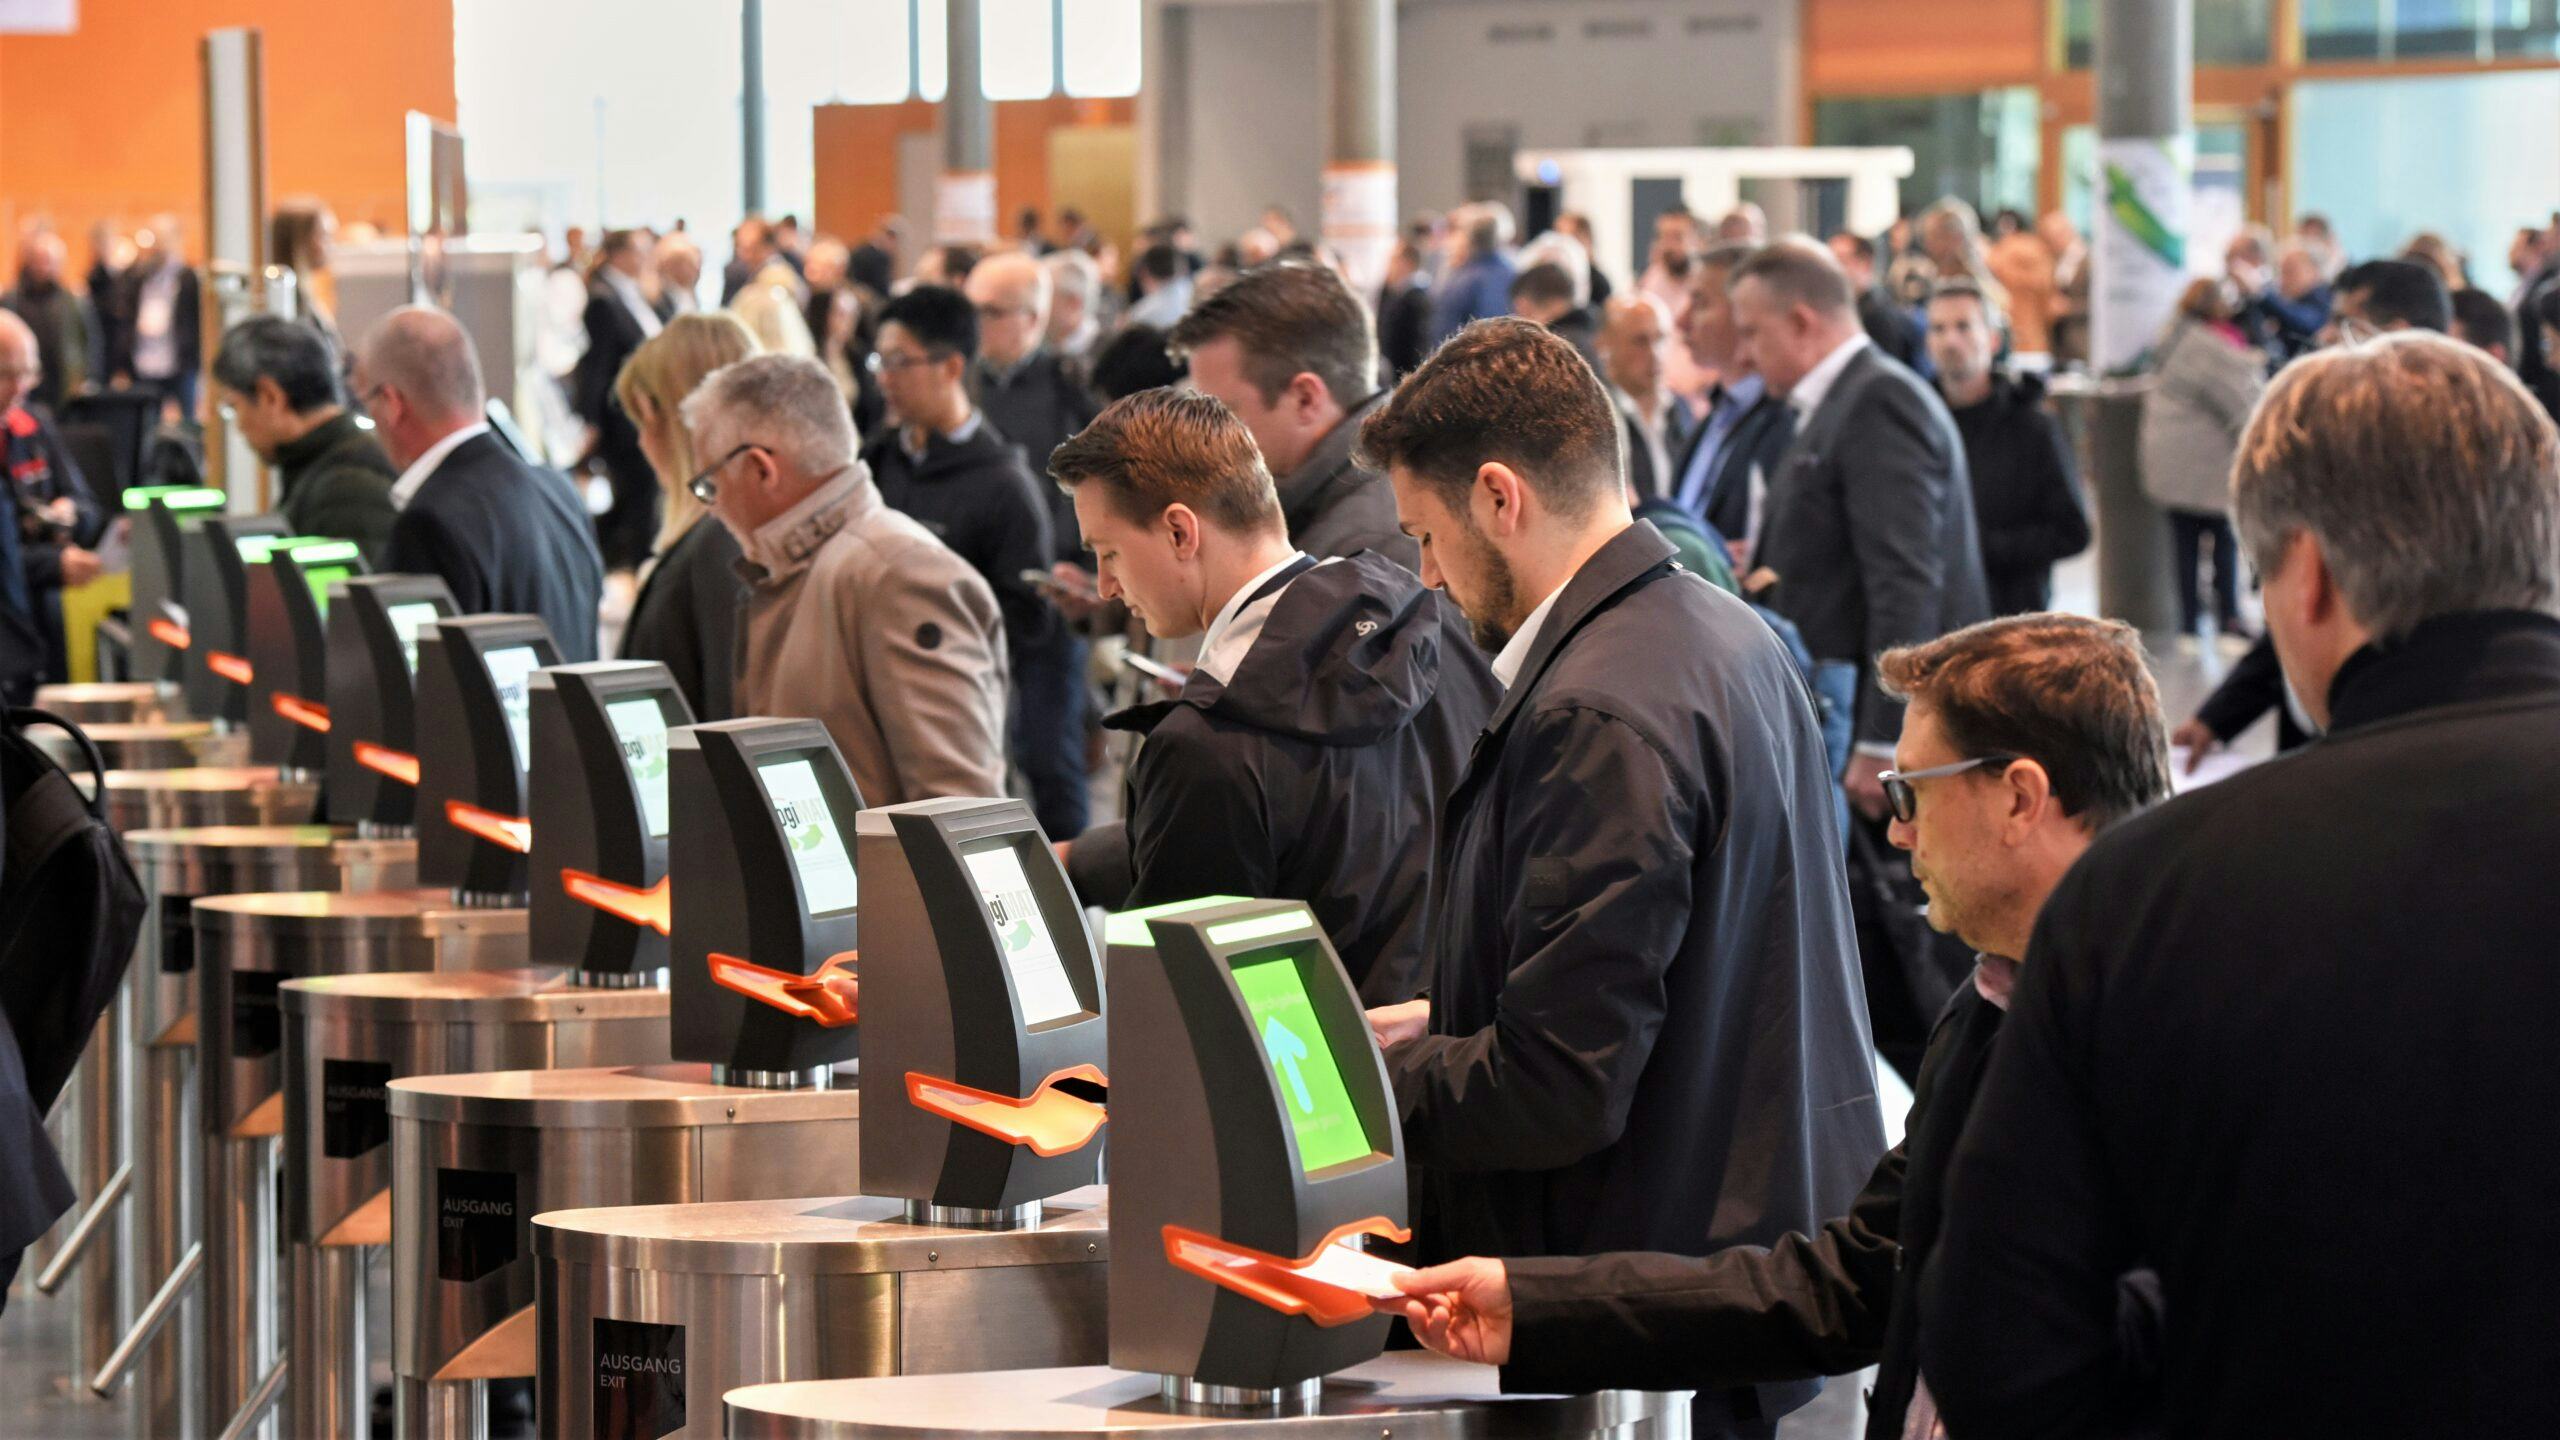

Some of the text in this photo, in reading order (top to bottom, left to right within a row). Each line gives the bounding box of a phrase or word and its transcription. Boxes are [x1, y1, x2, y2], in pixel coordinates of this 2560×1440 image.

[443, 1198, 513, 1216] AUSGANG
[443, 1216, 465, 1229] EXIT
[600, 1353, 681, 1375] AUSGANG
[600, 1374, 627, 1389] EXIT
